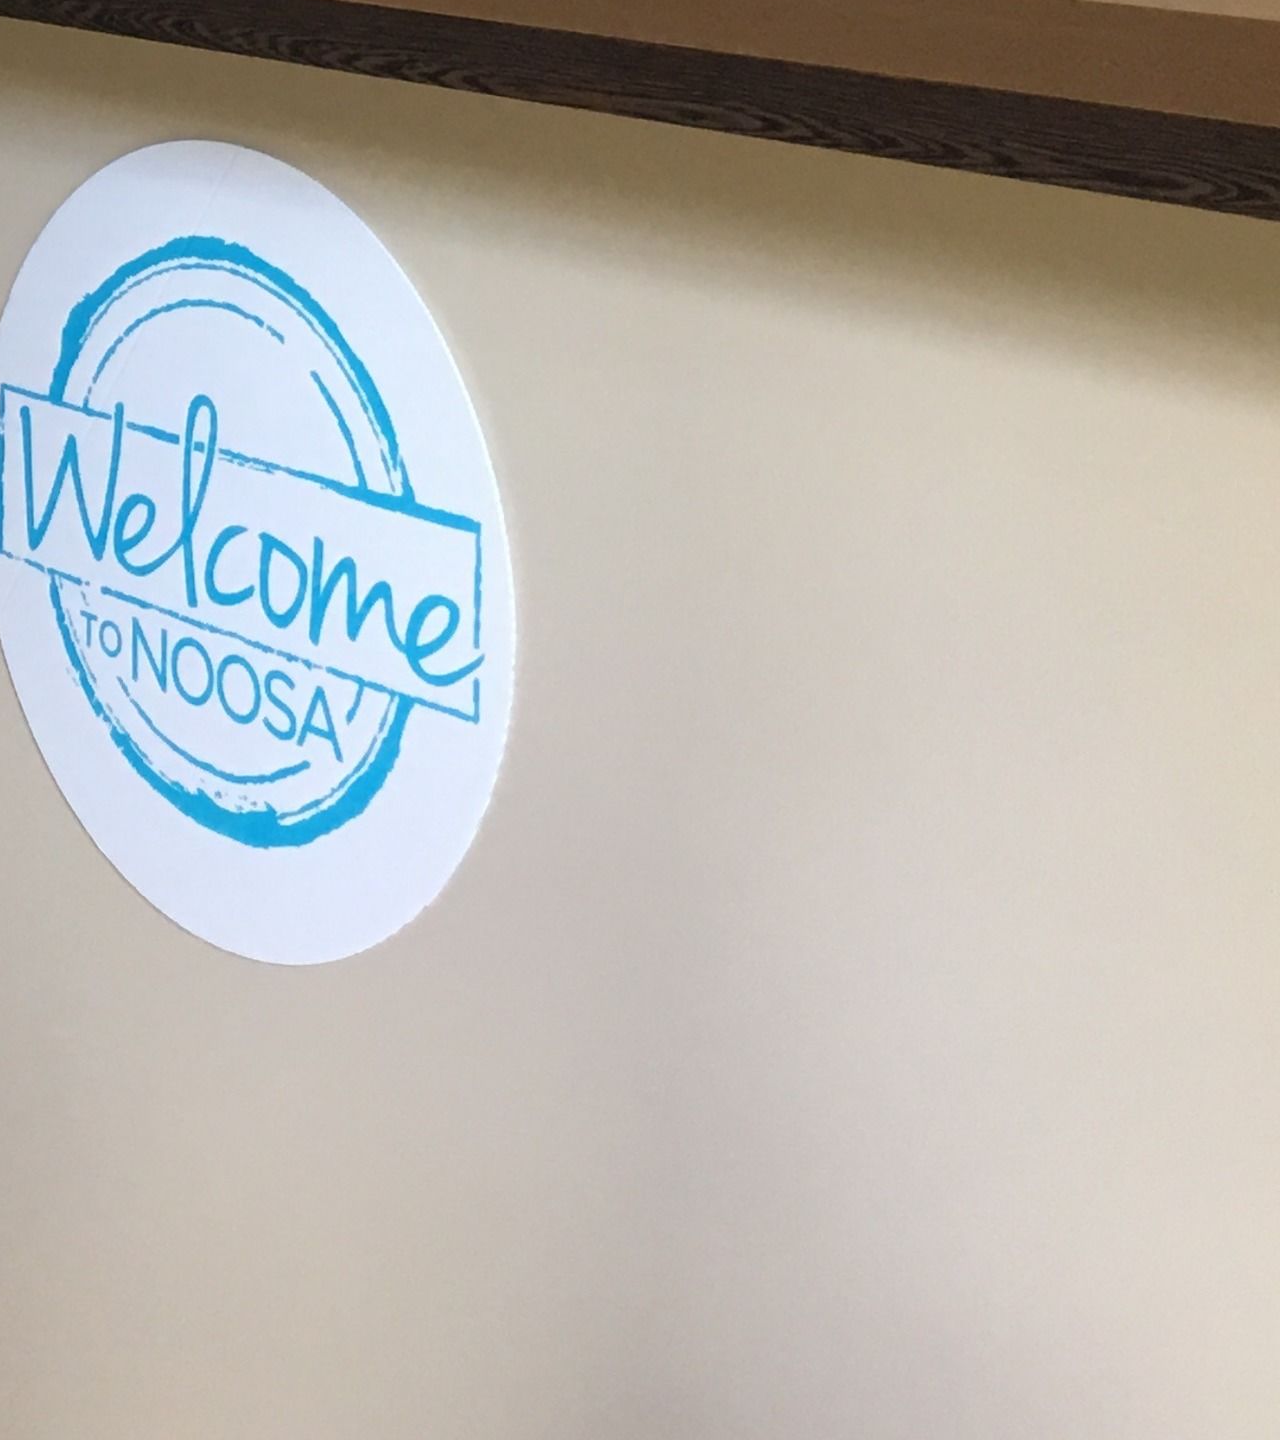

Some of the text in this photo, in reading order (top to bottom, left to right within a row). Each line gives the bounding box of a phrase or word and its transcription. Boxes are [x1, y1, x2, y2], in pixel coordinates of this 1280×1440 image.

[20, 394, 484, 685] Welcome
[81, 610, 344, 762] TO NOOSA
